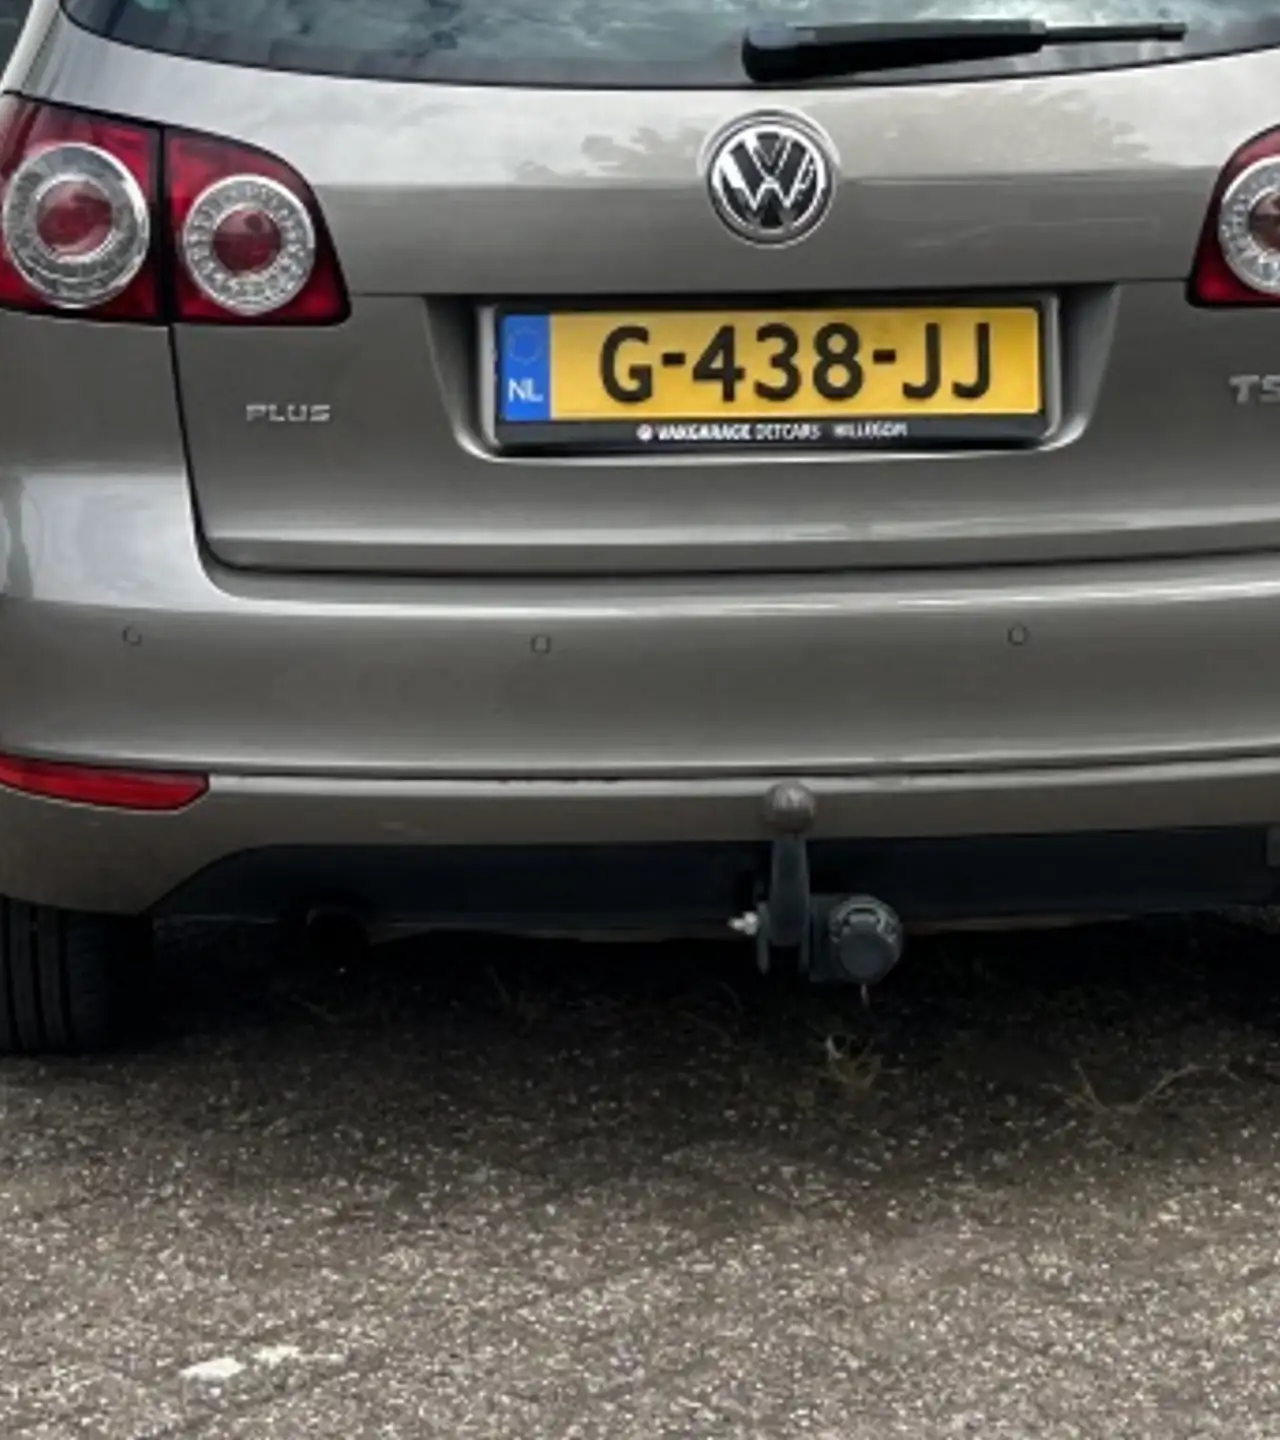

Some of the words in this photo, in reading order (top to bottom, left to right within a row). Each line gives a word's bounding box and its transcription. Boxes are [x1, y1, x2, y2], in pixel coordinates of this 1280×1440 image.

[600, 321, 991, 404] G-438-JJ
[508, 377, 544, 402] NL
[245, 403, 331, 422] PLUS
[656, 423, 751, 441] VAKGARAGE
[754, 422, 821, 440] DETCARS
